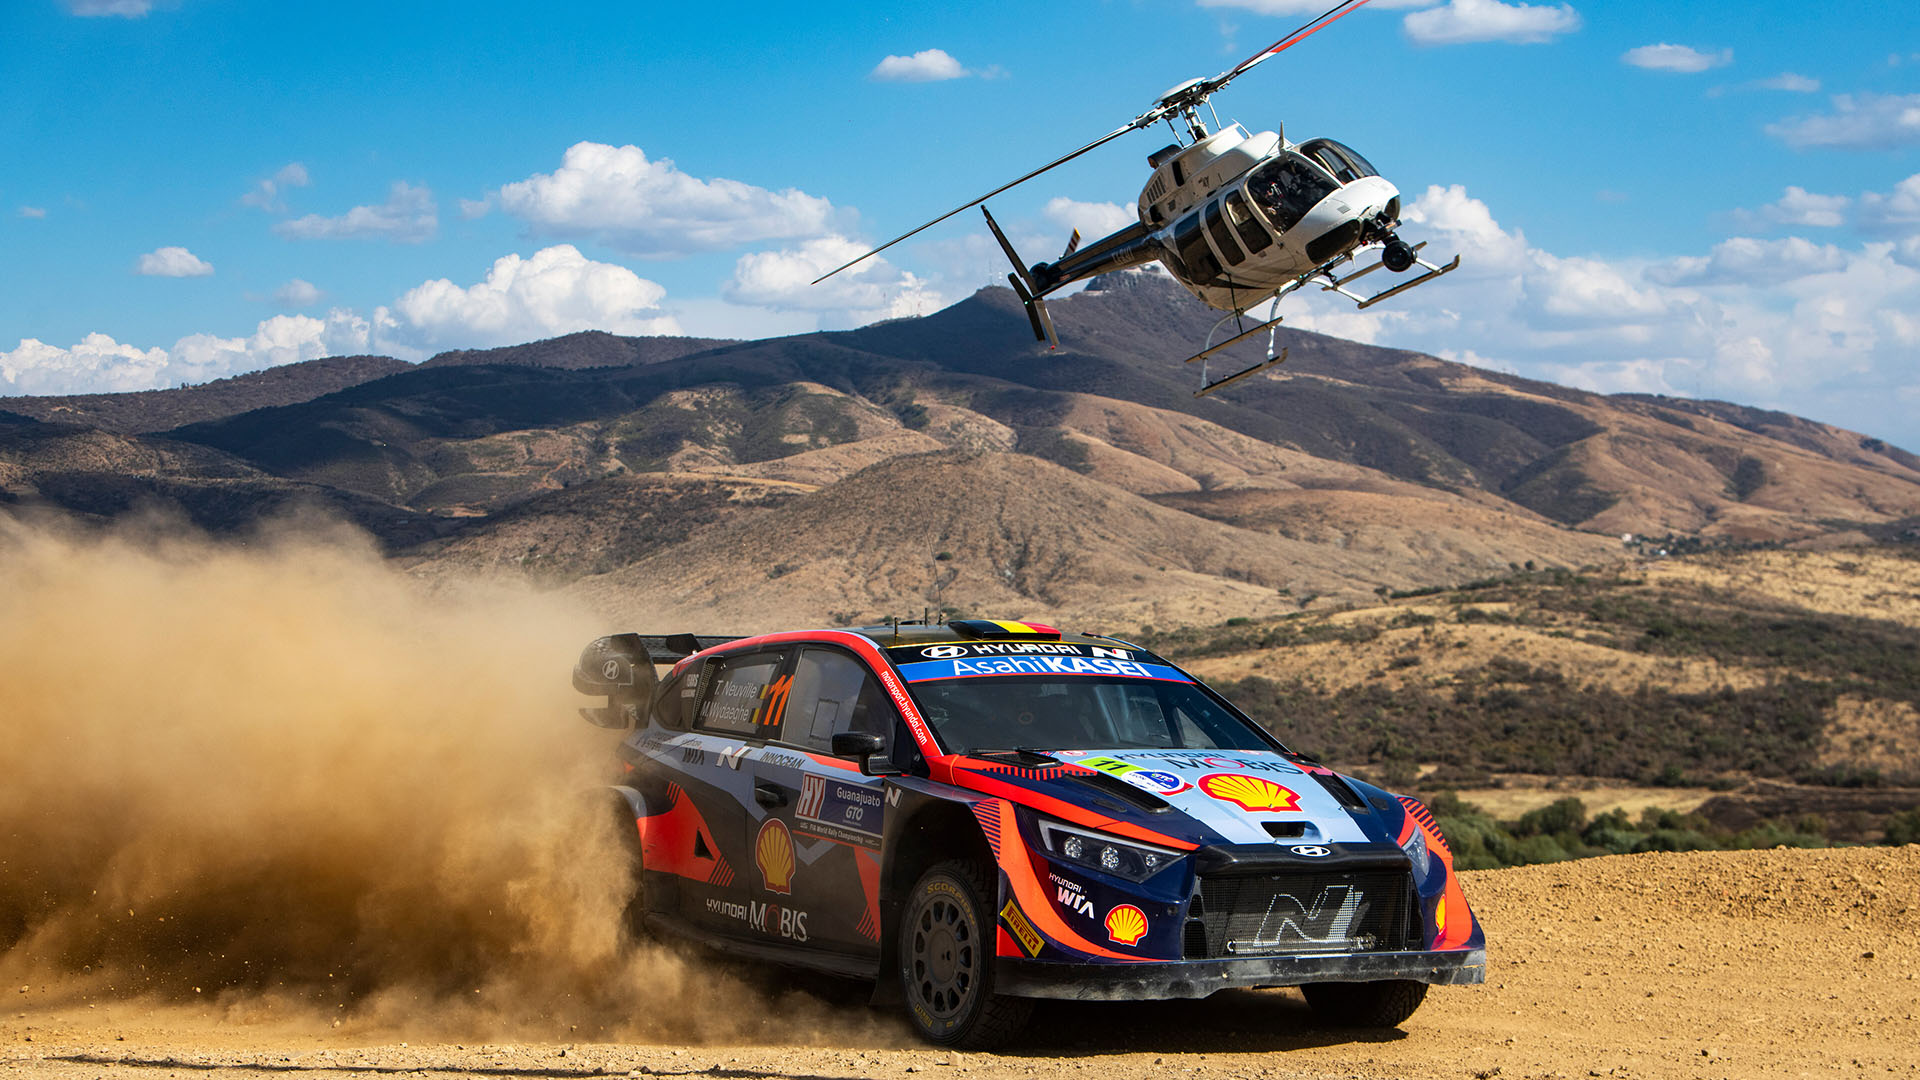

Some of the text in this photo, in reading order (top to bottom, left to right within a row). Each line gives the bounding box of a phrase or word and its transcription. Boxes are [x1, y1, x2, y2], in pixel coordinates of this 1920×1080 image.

[972, 643, 1082, 655] HYUNDAI
[723, 681, 757, 698] Neuville
[763, 674, 794, 726] 11
[881, 671, 928, 745] motorsport.hyundai.com
[760, 751, 805, 769] INNOCEAN
[1094, 760, 1128, 771] 11
[1113, 752, 1227, 761] HYUNDAI
[1163, 757, 1304, 775] MOBIS
[798, 776, 824, 817] HY
[836, 786, 881, 808] Guanajuato
[845, 805, 864, 820] GTO
[817, 825, 828, 834] World
[828, 826, 838, 837] Rally
[1048, 872, 1082, 893] HYUNDAI
[706, 898, 808, 942] HYUNDAI MOBIS
[1006, 905, 1040, 951] PIRELLI
